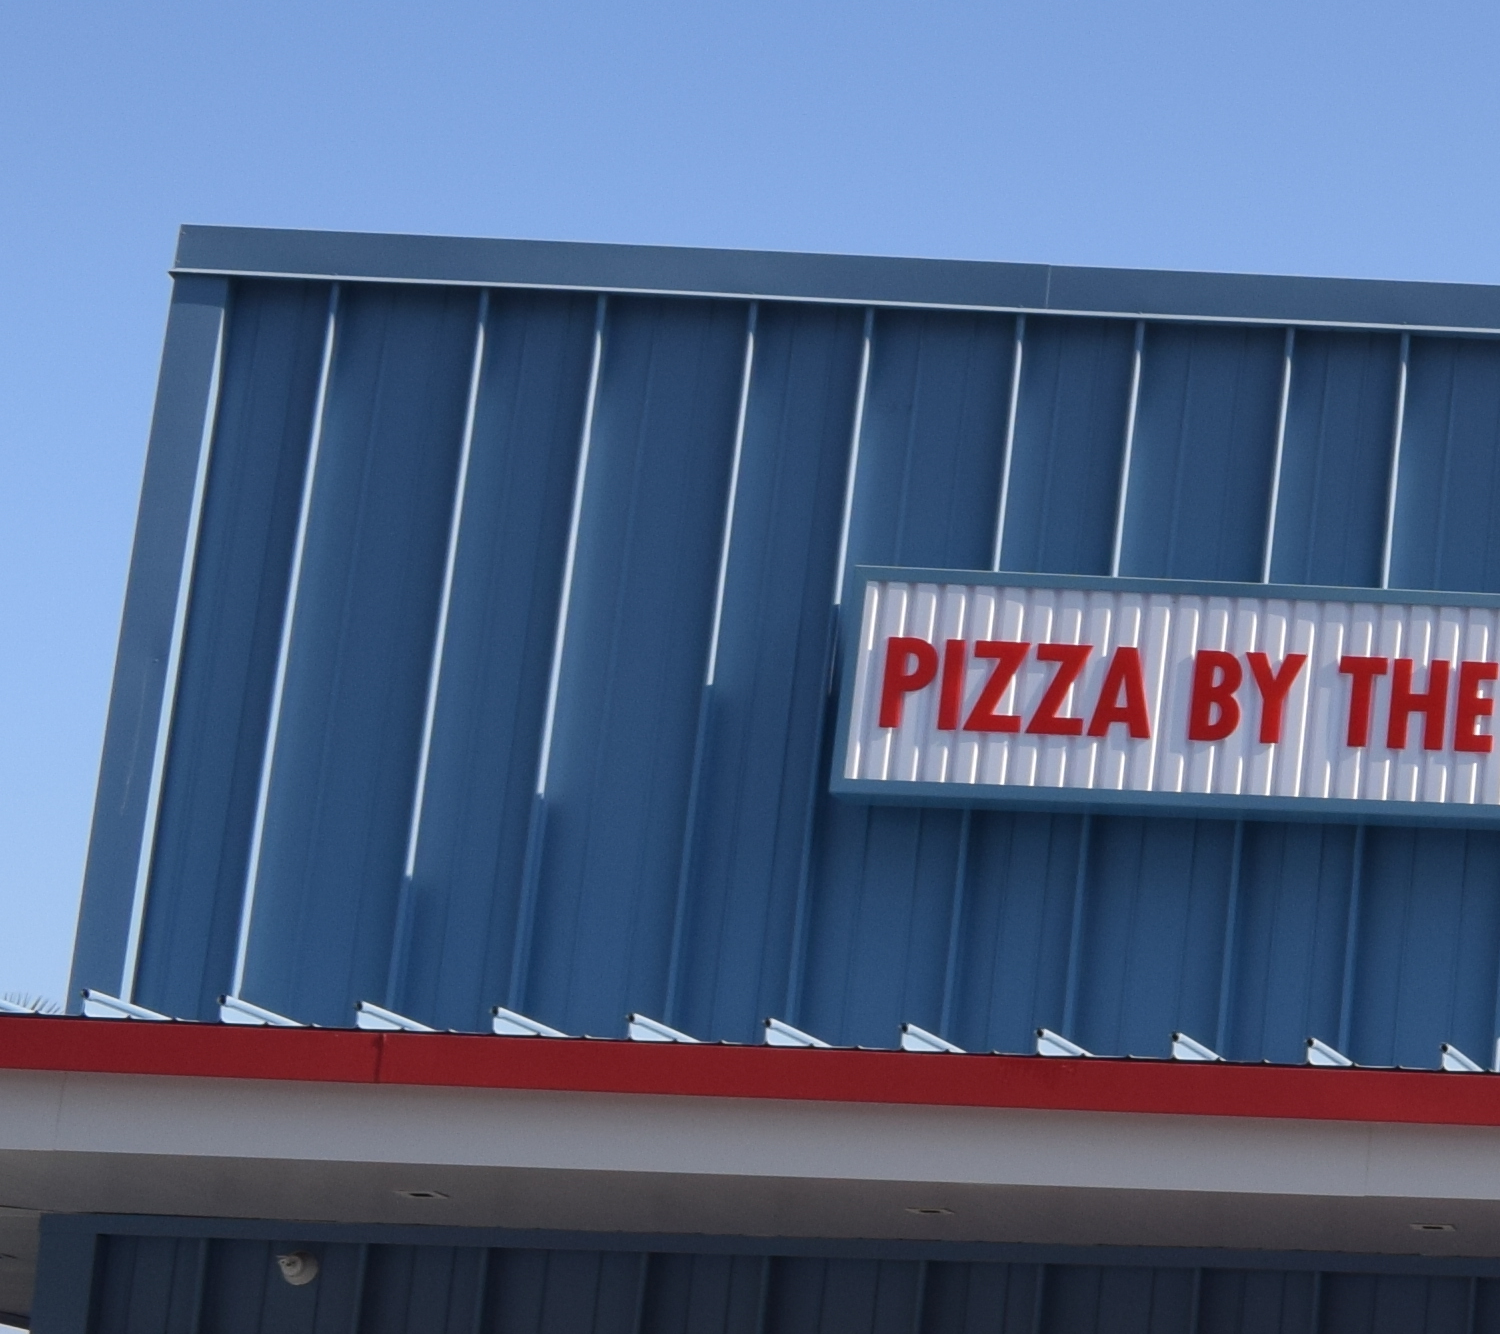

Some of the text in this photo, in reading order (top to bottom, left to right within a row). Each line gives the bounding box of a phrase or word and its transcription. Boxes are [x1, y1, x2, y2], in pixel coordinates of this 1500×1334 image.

[877, 636, 1151, 740] PIZZA
[1188, 649, 1308, 744] BY
[1337, 654, 1499, 753] THE
